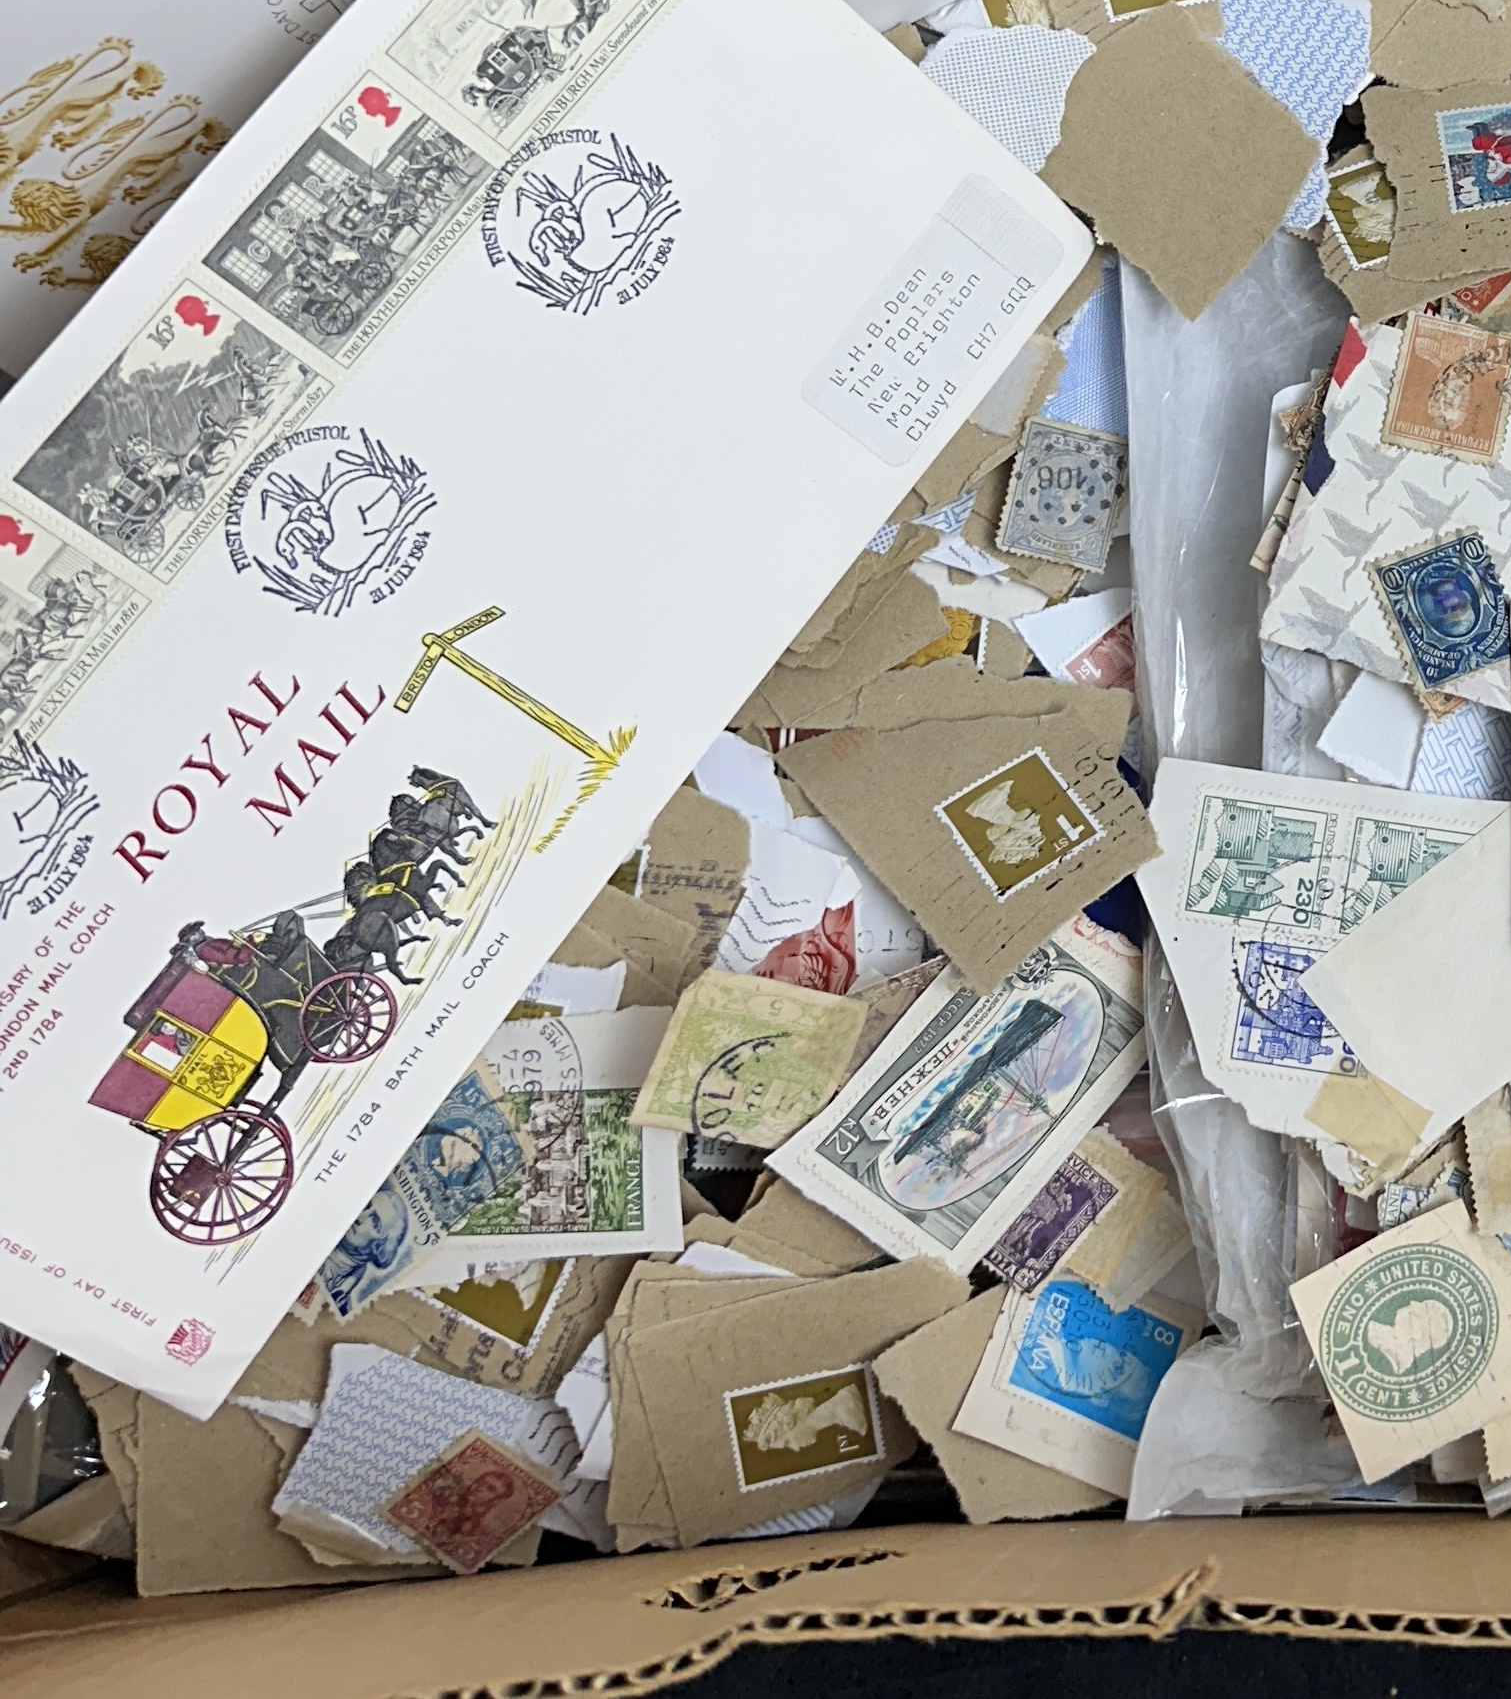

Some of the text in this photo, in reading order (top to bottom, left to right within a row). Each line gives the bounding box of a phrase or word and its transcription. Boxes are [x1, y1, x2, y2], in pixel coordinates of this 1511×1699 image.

[481, 223, 506, 268] FIRST
[629, 263, 662, 298] JULY
[653, 236, 676, 265] 1984
[848, 362, 885, 399] The
[886, 377, 931, 429] Mold
[905, 378, 958, 442] Clwyd
[966, 321, 998, 361] CH7
[385, 559, 418, 597] JULY
[409, 530, 432, 564] 1984
[443, 607, 500, 643] LONDON
[401, 653, 438, 702] BRISTOL
[112, 670, 301, 884] ROYAL
[244, 680, 387, 837] MAIL
[41, 867, 78, 909] JULY
[68, 833, 95, 874] 1984
[34, 935, 55, 958] OF
[54, 900, 87, 931] THE
[38, 961, 73, 994] MAIL
[69, 902, 116, 955] COACH
[3, 1008, 65, 1080] 2ND 1784
[314, 931, 511, 1185] THE 1784 BATH MAIL COACH
[625, 1152, 642, 1229] FRANCE
[43, 1264, 67, 1279] OF
[73, 1277, 107, 1300] DAY
[111, 1297, 158, 1327] FIRST
[1337, 1292, 1366, 1335] ONE
[1379, 1260, 1484, 1399] UNITED STATES POSTAGE
[1354, 1379, 1402, 1407] CENT
